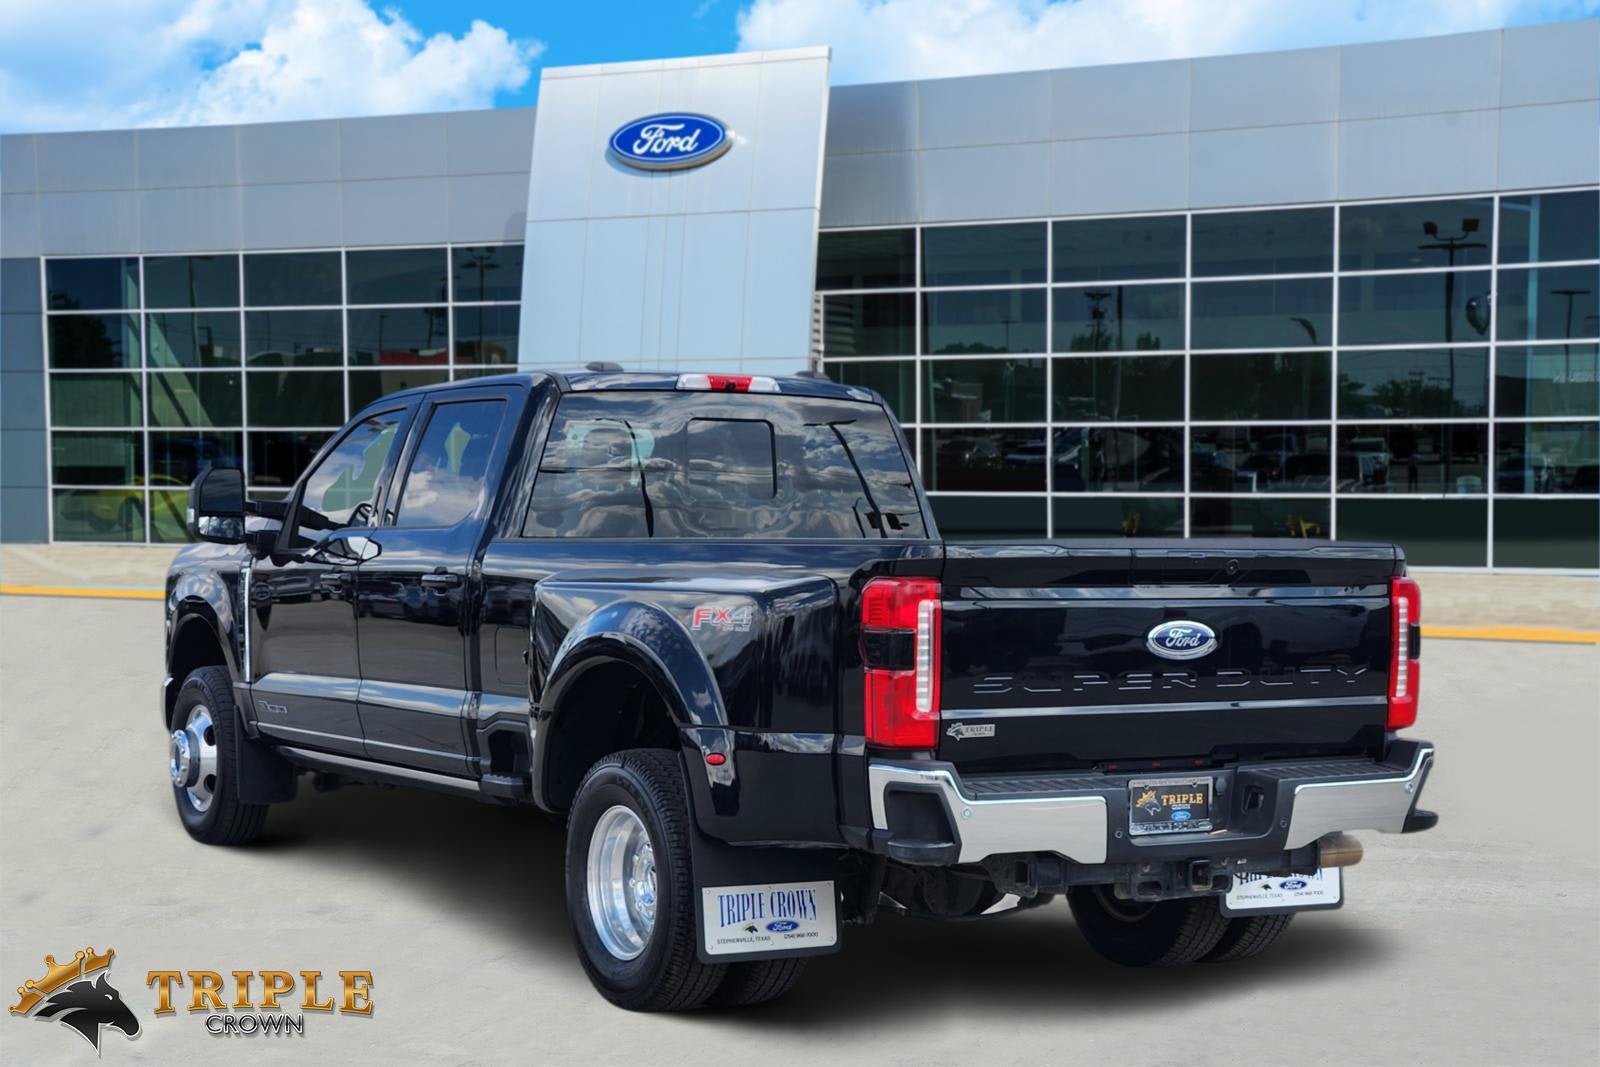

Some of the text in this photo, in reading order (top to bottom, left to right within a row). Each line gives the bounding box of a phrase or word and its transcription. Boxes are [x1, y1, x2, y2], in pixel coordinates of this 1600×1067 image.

[632, 123, 702, 155] Ford
[691, 605, 752, 628] FX4
[1165, 627, 1202, 648] Ford
[973, 666, 1369, 694] SUPER DUTY
[1161, 792, 1204, 806] TRIPLE
[717, 888, 817, 928] TRIPLE CROWN
[771, 920, 795, 932] Ford
